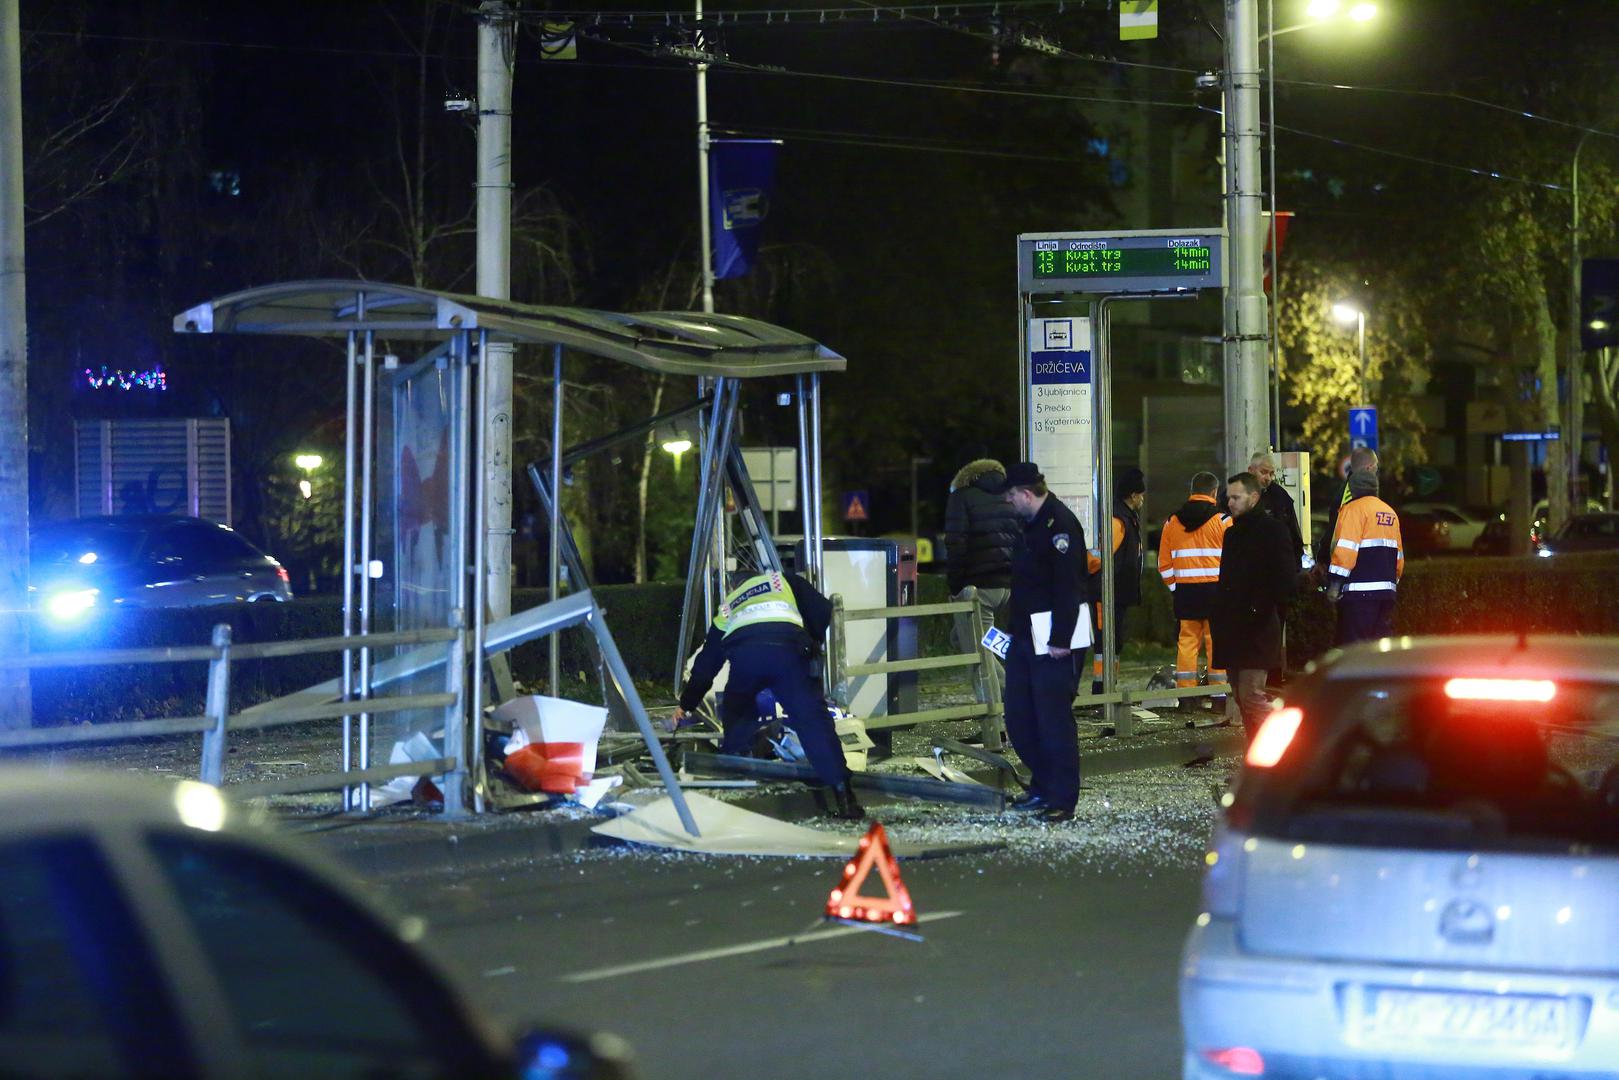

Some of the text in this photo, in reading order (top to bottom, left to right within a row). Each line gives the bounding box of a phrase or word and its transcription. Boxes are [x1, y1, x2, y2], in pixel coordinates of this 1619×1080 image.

[1037, 242, 1057, 250] Linija
[1169, 239, 1199, 248] Dolazak
[1039, 247, 1209, 261] 13 Kvat. trg 14min
[1039, 259, 1209, 273] 13 Kvat. trg 14min
[1035, 360, 1086, 374] DRŽIĆEVA
[1037, 386, 1087, 397] 3 Ljubljanica
[1036, 403, 1072, 413] 5 Prečko
[1034, 418, 1091, 432] 13 Kvaternikov
[1376, 511, 1396, 527] ZET
[730, 582, 770, 610] POLICIJA
